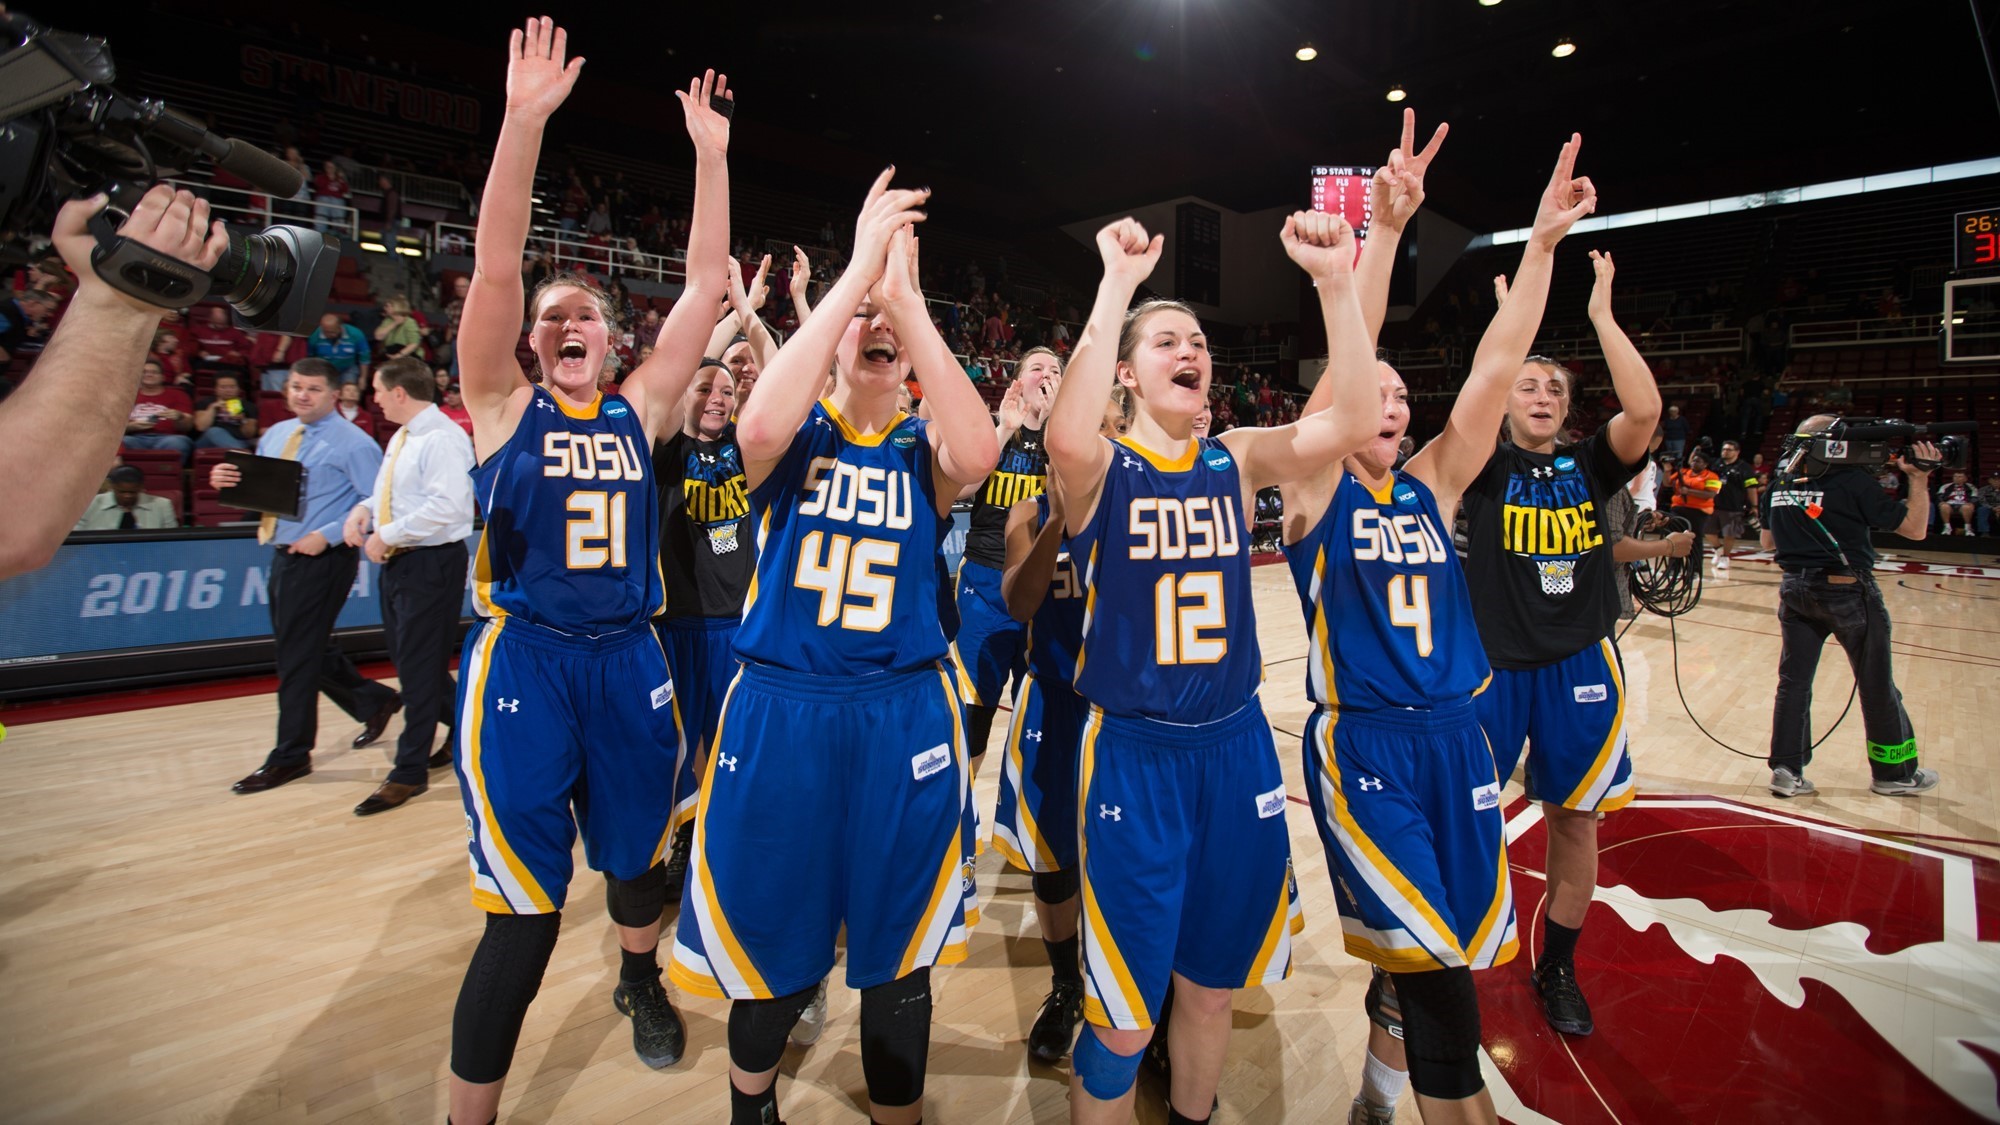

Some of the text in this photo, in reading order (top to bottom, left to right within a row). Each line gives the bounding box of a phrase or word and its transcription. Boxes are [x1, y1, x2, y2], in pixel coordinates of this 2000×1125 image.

[240, 44, 481, 135] STANFORD
[1313, 178, 1326, 186] PLY
[1336, 178, 1349, 186] FLS
[1361, 168, 1371, 176] 74
[1976, 233, 2000, 263] 3
[544, 431, 643, 481] SDSU
[798, 456, 912, 530] SDSU
[986, 470, 1047, 507] MOR
[566, 490, 627, 569] 21
[1129, 496, 1240, 560] SDSU
[1353, 508, 1447, 565] SDSU
[1503, 501, 1603, 555] MORE
[80, 568, 226, 618] 2016
[794, 530, 900, 632] 45
[1155, 571, 1228, 665] 12
[1387, 574, 1433, 657] 4
